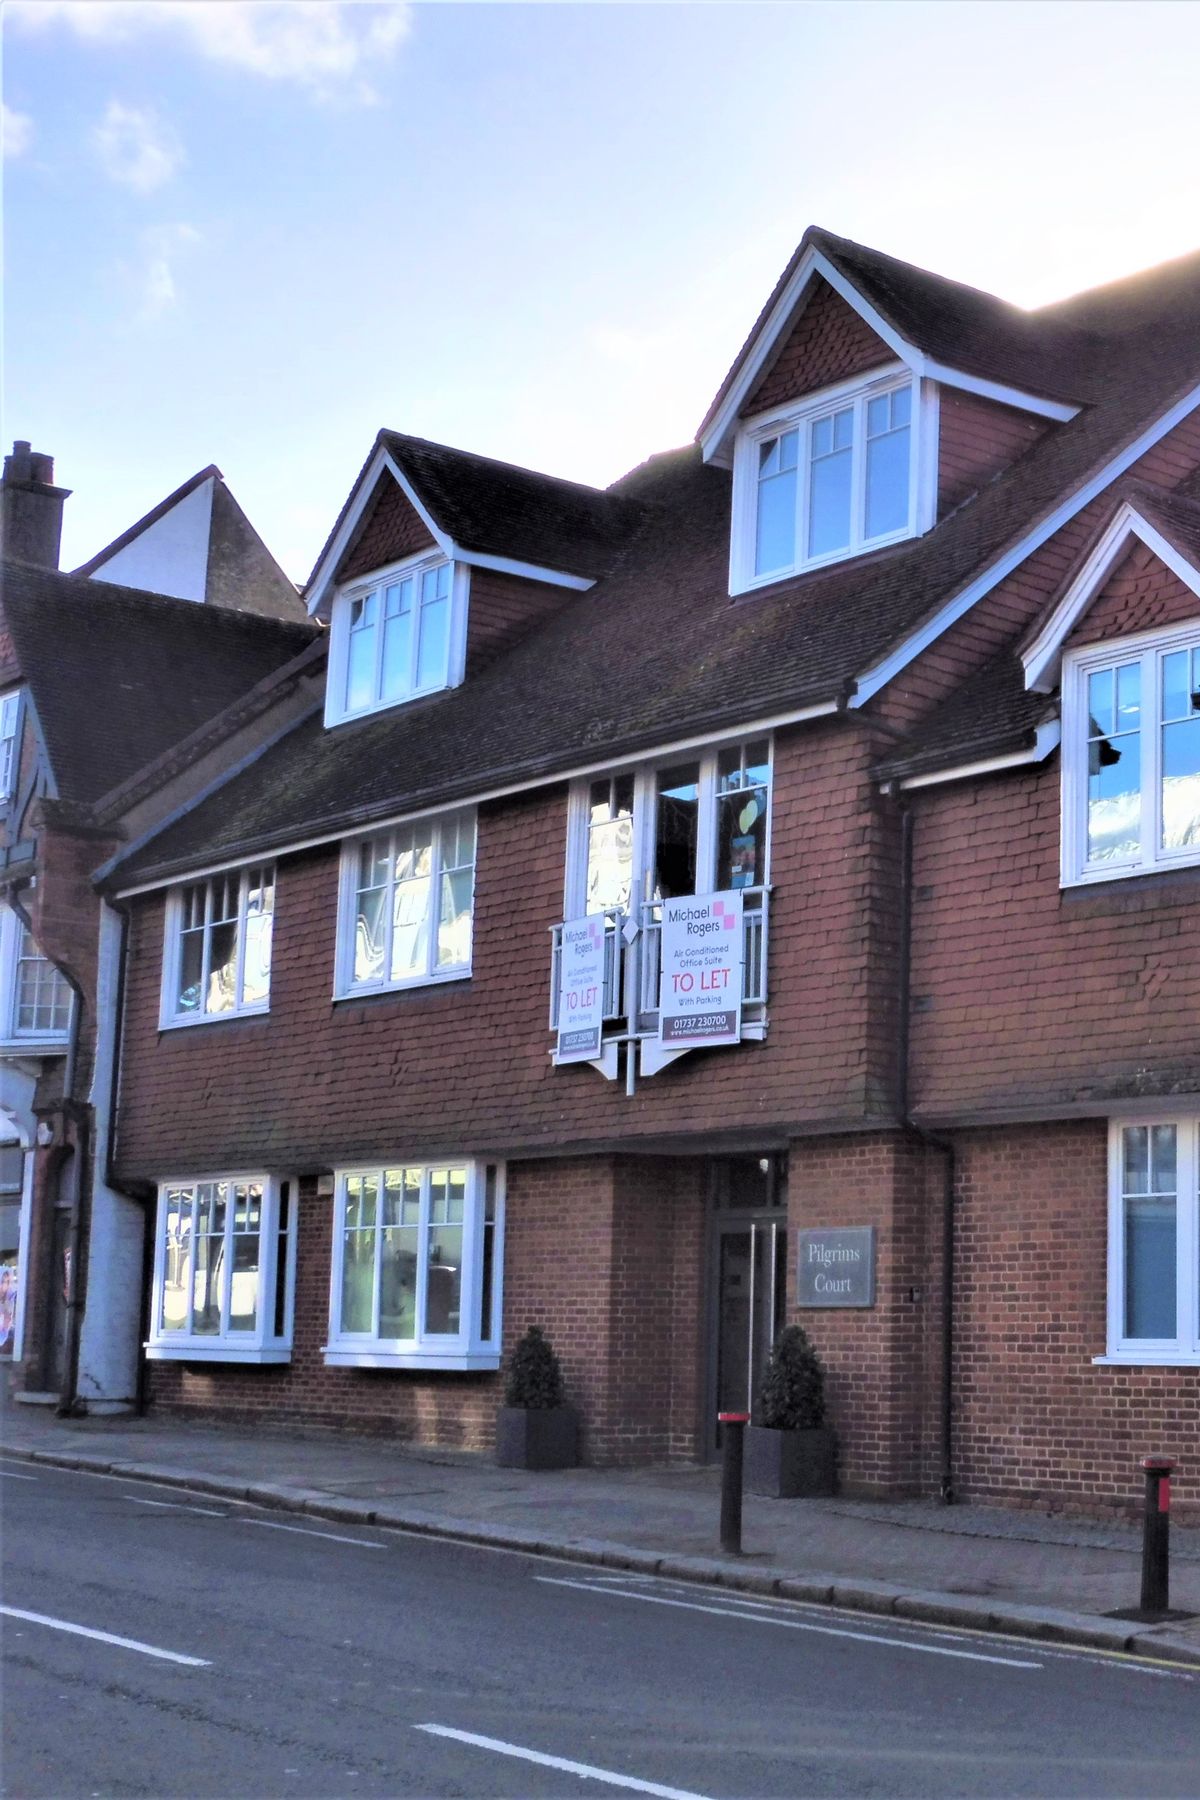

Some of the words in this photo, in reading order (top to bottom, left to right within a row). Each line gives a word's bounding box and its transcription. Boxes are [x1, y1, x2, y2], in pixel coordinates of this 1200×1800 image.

[668, 905, 710, 923] Michael
[687, 921, 720, 937] Rogers
[674, 949, 684, 958] Air
[685, 944, 729, 957] Conditioned
[680, 959, 703, 968] Office
[704, 956, 723, 965] Suite
[672, 972, 694, 993] TO
[701, 968, 731, 990] LET
[566, 991, 578, 1011] TO
[581, 986, 598, 1008] LET
[696, 995, 722, 1005] Parking
[674, 1018, 697, 1029] 01737
[697, 1015, 727, 1027] 230700
[808, 1243, 860, 1268] Pilgrims
[814, 1273, 852, 1293] Court
